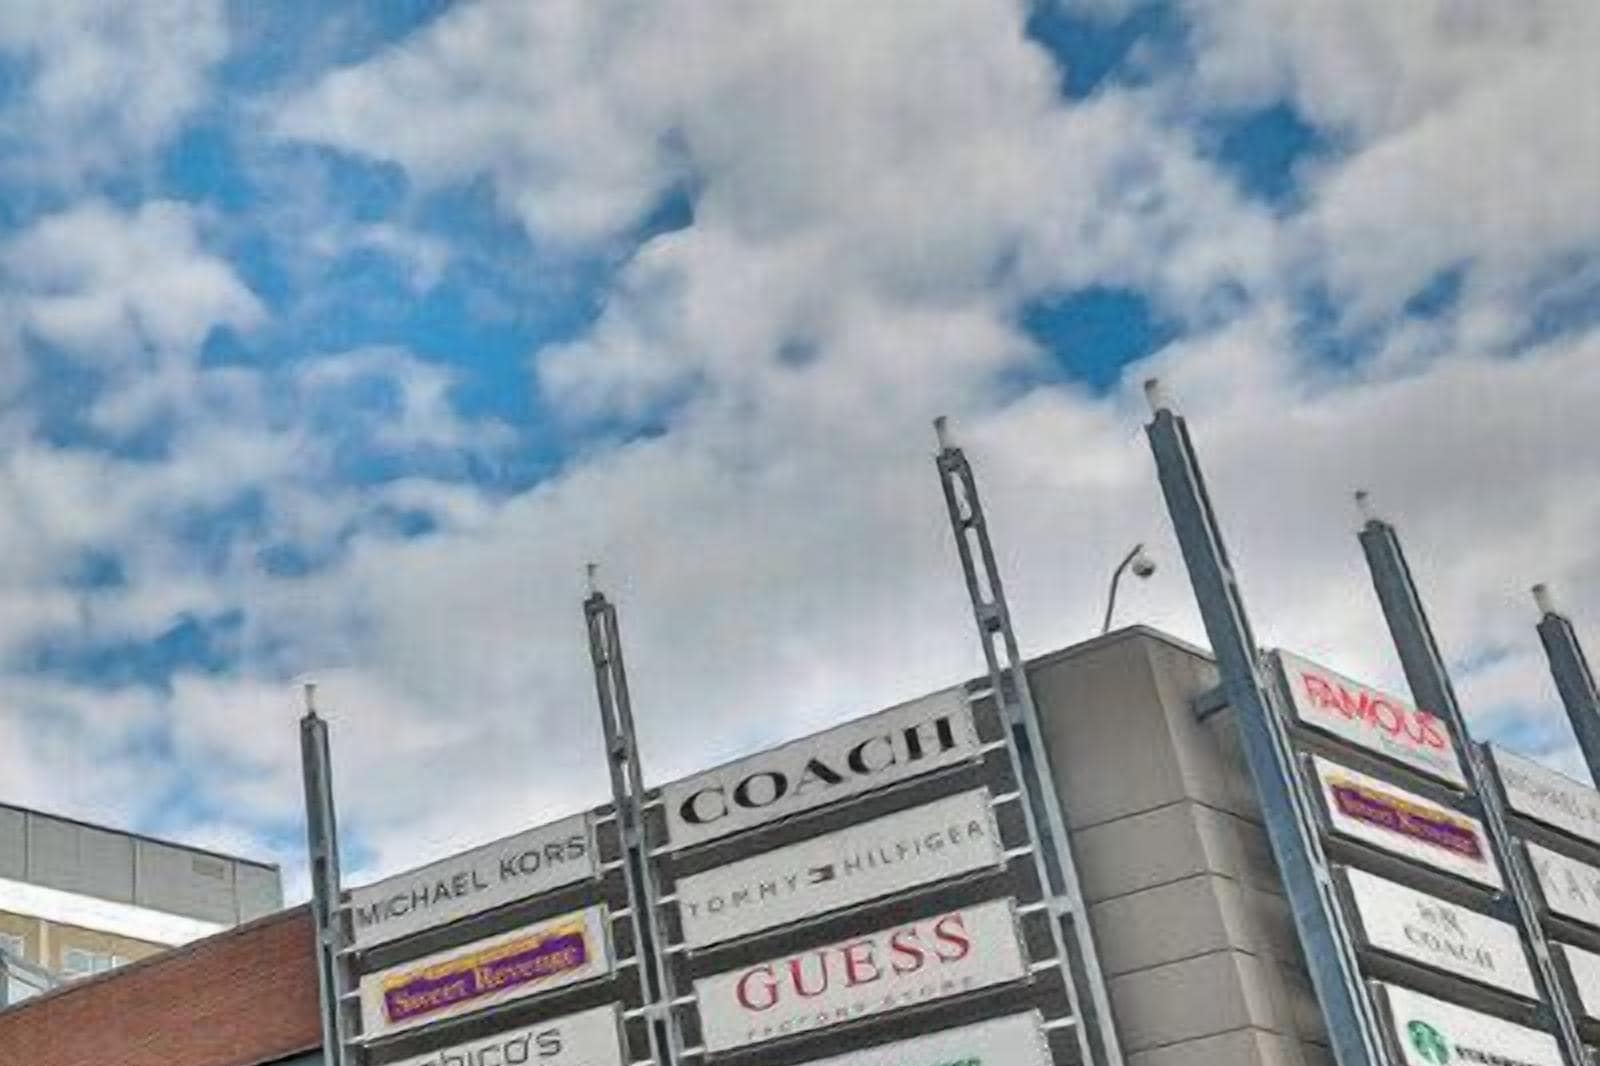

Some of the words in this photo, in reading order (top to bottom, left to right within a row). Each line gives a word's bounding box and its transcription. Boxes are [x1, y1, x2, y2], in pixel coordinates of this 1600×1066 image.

[1302, 672, 1445, 749] FAMOUS
[679, 716, 957, 825] COACH
[355, 869, 489, 926] MICHAEL
[500, 834, 586, 880] KORS
[689, 868, 798, 919] TOMMY
[843, 819, 985, 872] HILFIGER
[735, 911, 971, 1012] GUESS
